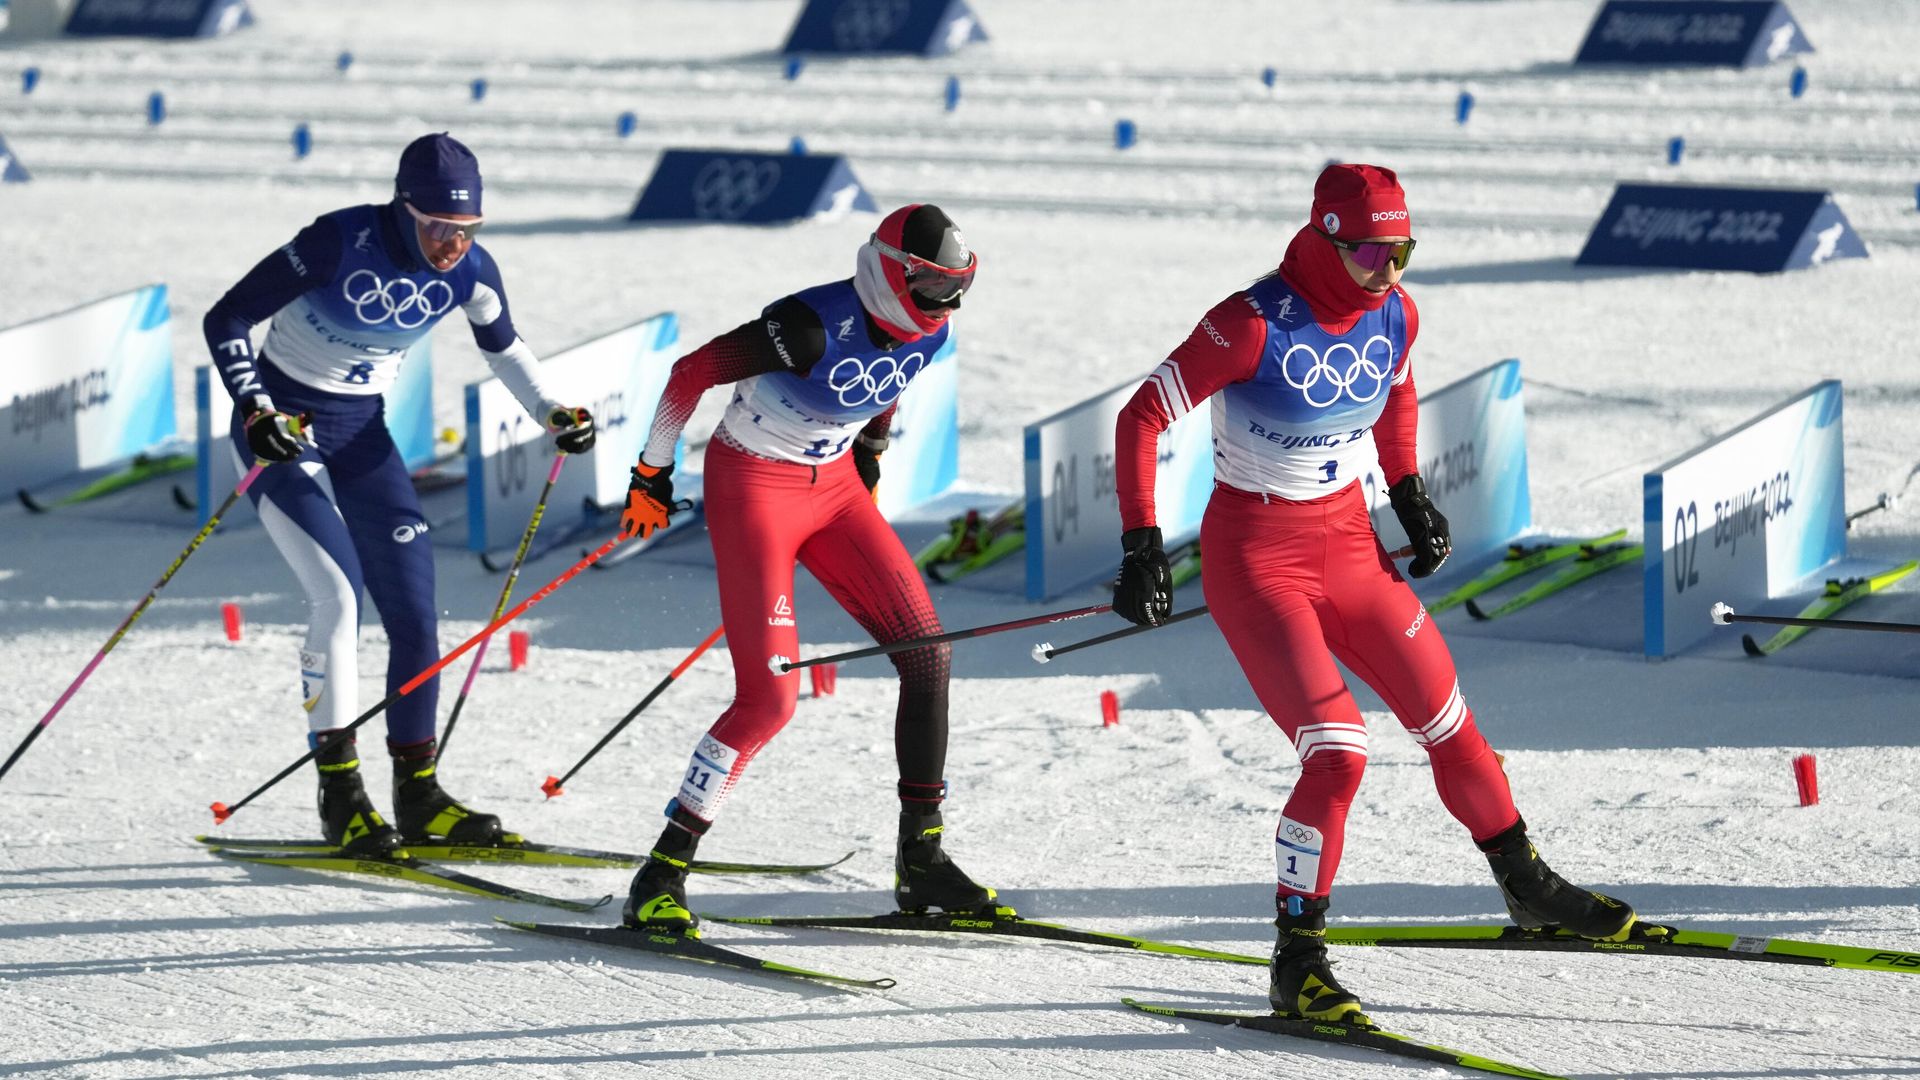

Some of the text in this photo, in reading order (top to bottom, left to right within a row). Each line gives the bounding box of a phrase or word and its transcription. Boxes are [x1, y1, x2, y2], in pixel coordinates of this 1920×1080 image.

[1371, 209, 1405, 222] BOSCO
[1611, 205, 1783, 249] BEIJING 2022
[1201, 317, 1225, 346] BOSCO
[773, 335, 796, 368] Löffler
[217, 338, 263, 396] FIN
[1249, 419, 1341, 450] BEIJING
[497, 415, 527, 498] 06
[1318, 460, 1339, 484] 1
[1053, 453, 1080, 544] 04
[1714, 469, 1793, 558] BEIJING 2022
[1674, 500, 1699, 595] 02
[687, 765, 712, 792] 11
[448, 848, 526, 861] FISCHER
[1286, 855, 1298, 875] 1
[949, 918, 994, 929] FISCHER
[1593, 942, 1646, 951] FISCHER
[1312, 1025, 1349, 1037] FISCHER
